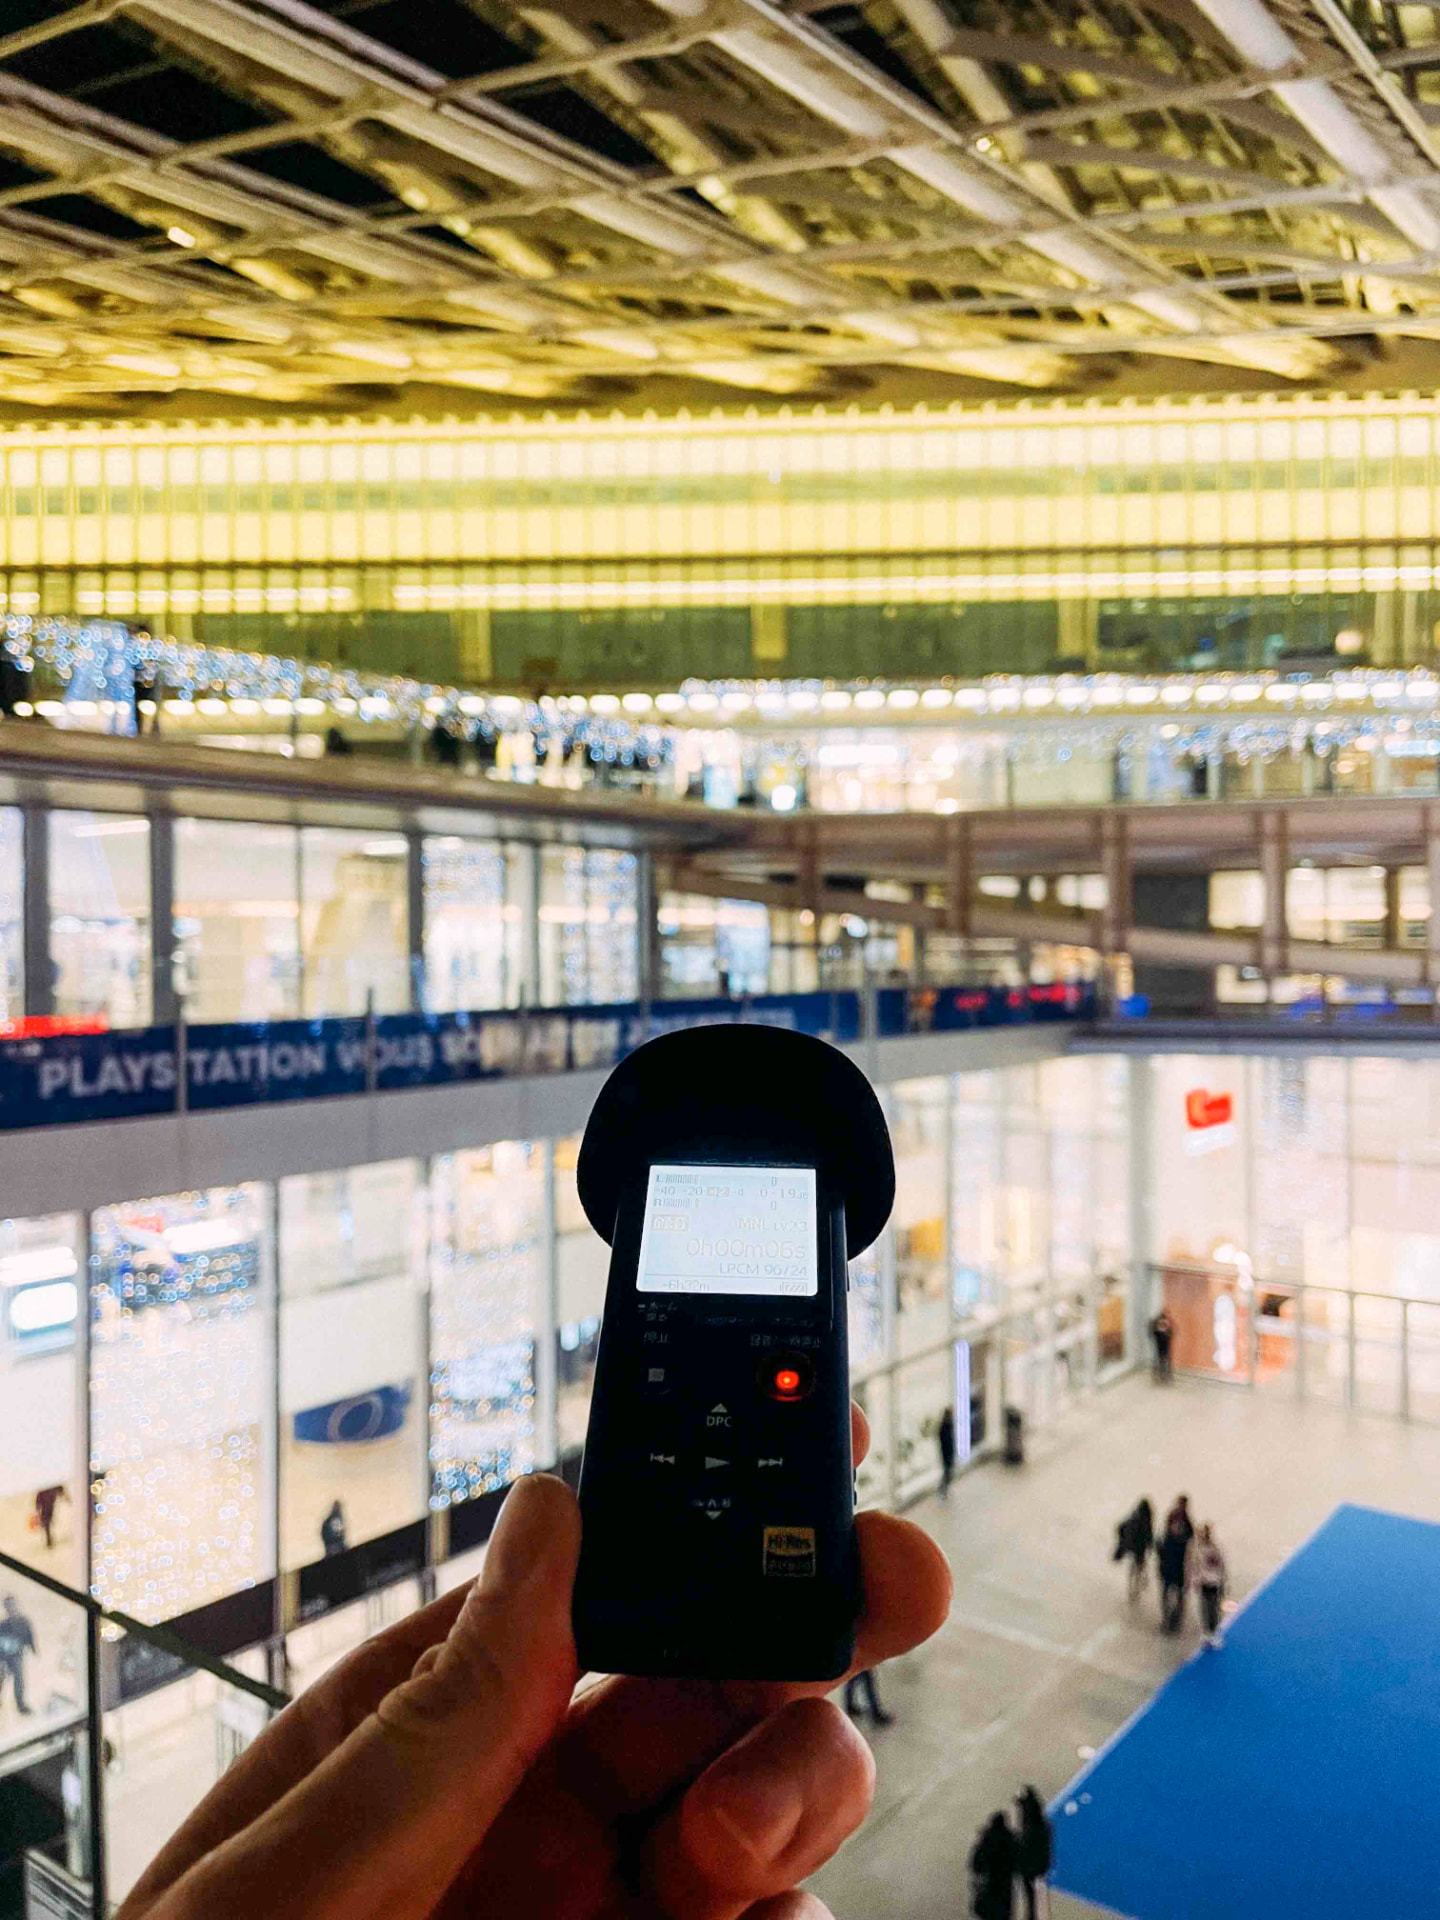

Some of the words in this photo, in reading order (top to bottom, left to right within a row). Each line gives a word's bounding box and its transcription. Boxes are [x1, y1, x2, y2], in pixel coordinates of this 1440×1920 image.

[37, 1043, 326, 1100] PLAYSTATION
[685, 1237, 807, 1259] 0h00m06s
[719, 1262, 759, 1276] LPCM
[763, 1263, 808, 1277] 96/24
[706, 1415, 732, 1428] DPC
